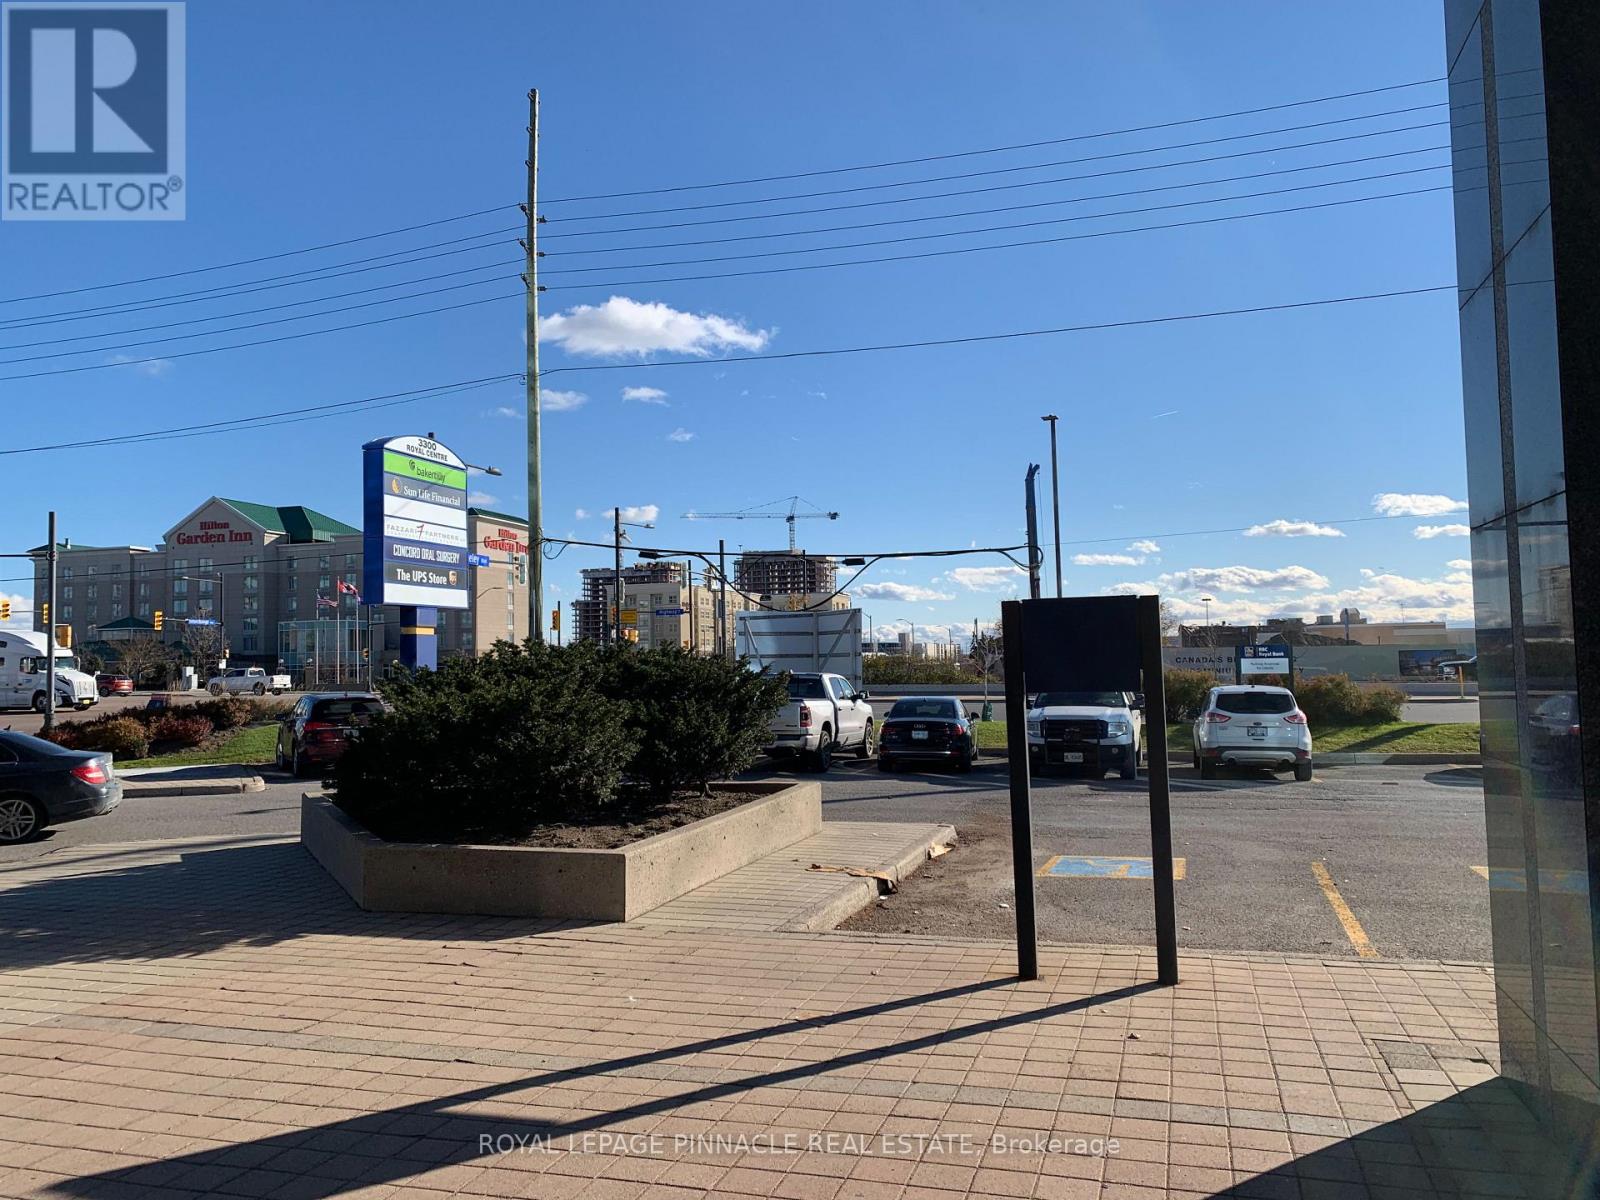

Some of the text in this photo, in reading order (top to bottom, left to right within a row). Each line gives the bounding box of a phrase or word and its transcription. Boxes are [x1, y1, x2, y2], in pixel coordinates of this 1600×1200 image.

[406, 444, 449, 462] ROYAL CENTRE
[418, 439, 437, 451] 3300
[403, 485, 461, 506] Sun Life Financial
[199, 521, 230, 531] Hilton
[176, 530, 253, 545] Garden Inn
[483, 535, 515, 553] Garden
[392, 544, 460, 564] CONCORD ORAL SURGERY
[396, 568, 411, 582] The
[412, 570, 427, 583] UPS
[428, 573, 448, 585] Store
[1175, 656, 1223, 664] CANADAS
